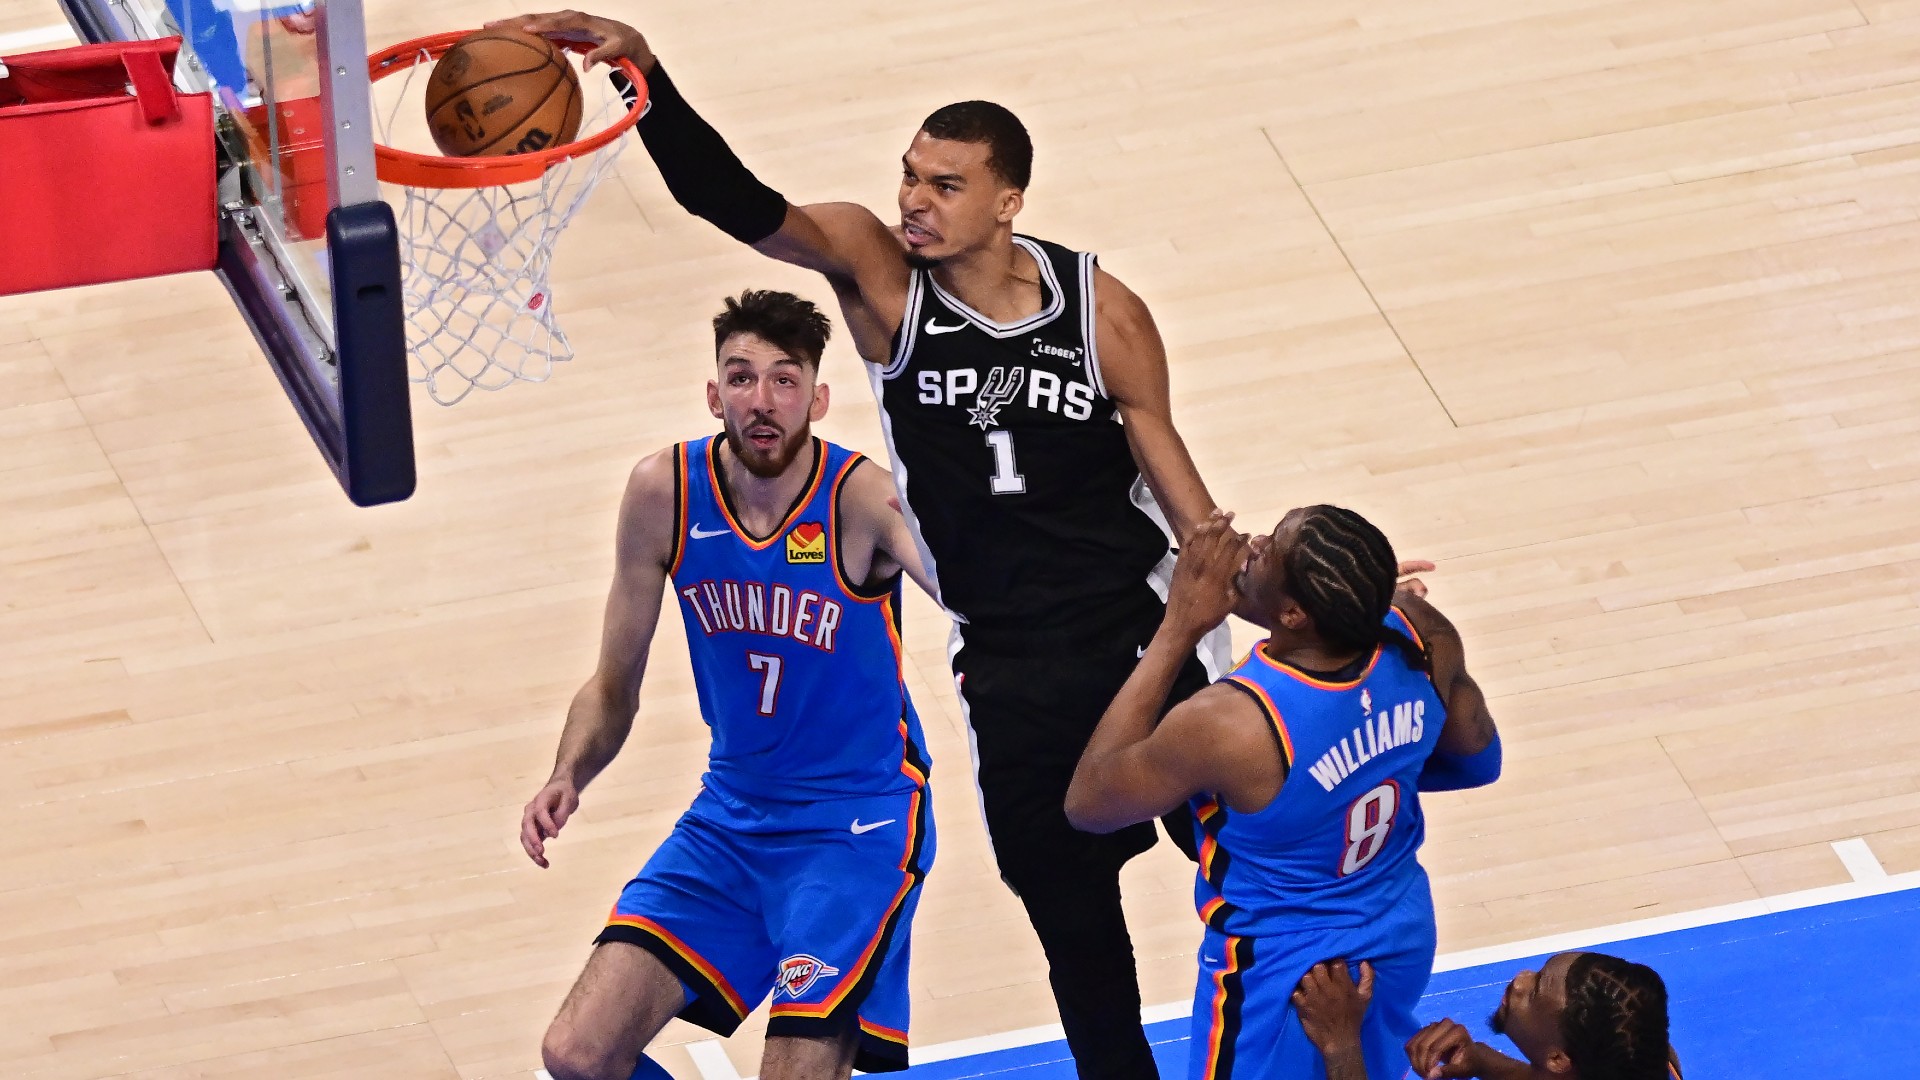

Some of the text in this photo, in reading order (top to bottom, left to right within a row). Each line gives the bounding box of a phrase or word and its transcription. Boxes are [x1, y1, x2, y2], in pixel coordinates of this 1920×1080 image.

[1037, 343, 1076, 361] LEDGER
[918, 366, 1094, 430] SPURS
[985, 430, 1026, 495] 1
[789, 547, 824, 560] Love's
[682, 579, 843, 653] THUNDER
[747, 650, 784, 717] 7
[1308, 700, 1425, 792] WILLIAMS
[1337, 779, 1400, 878] 8
[780, 964, 812, 988] OKC
